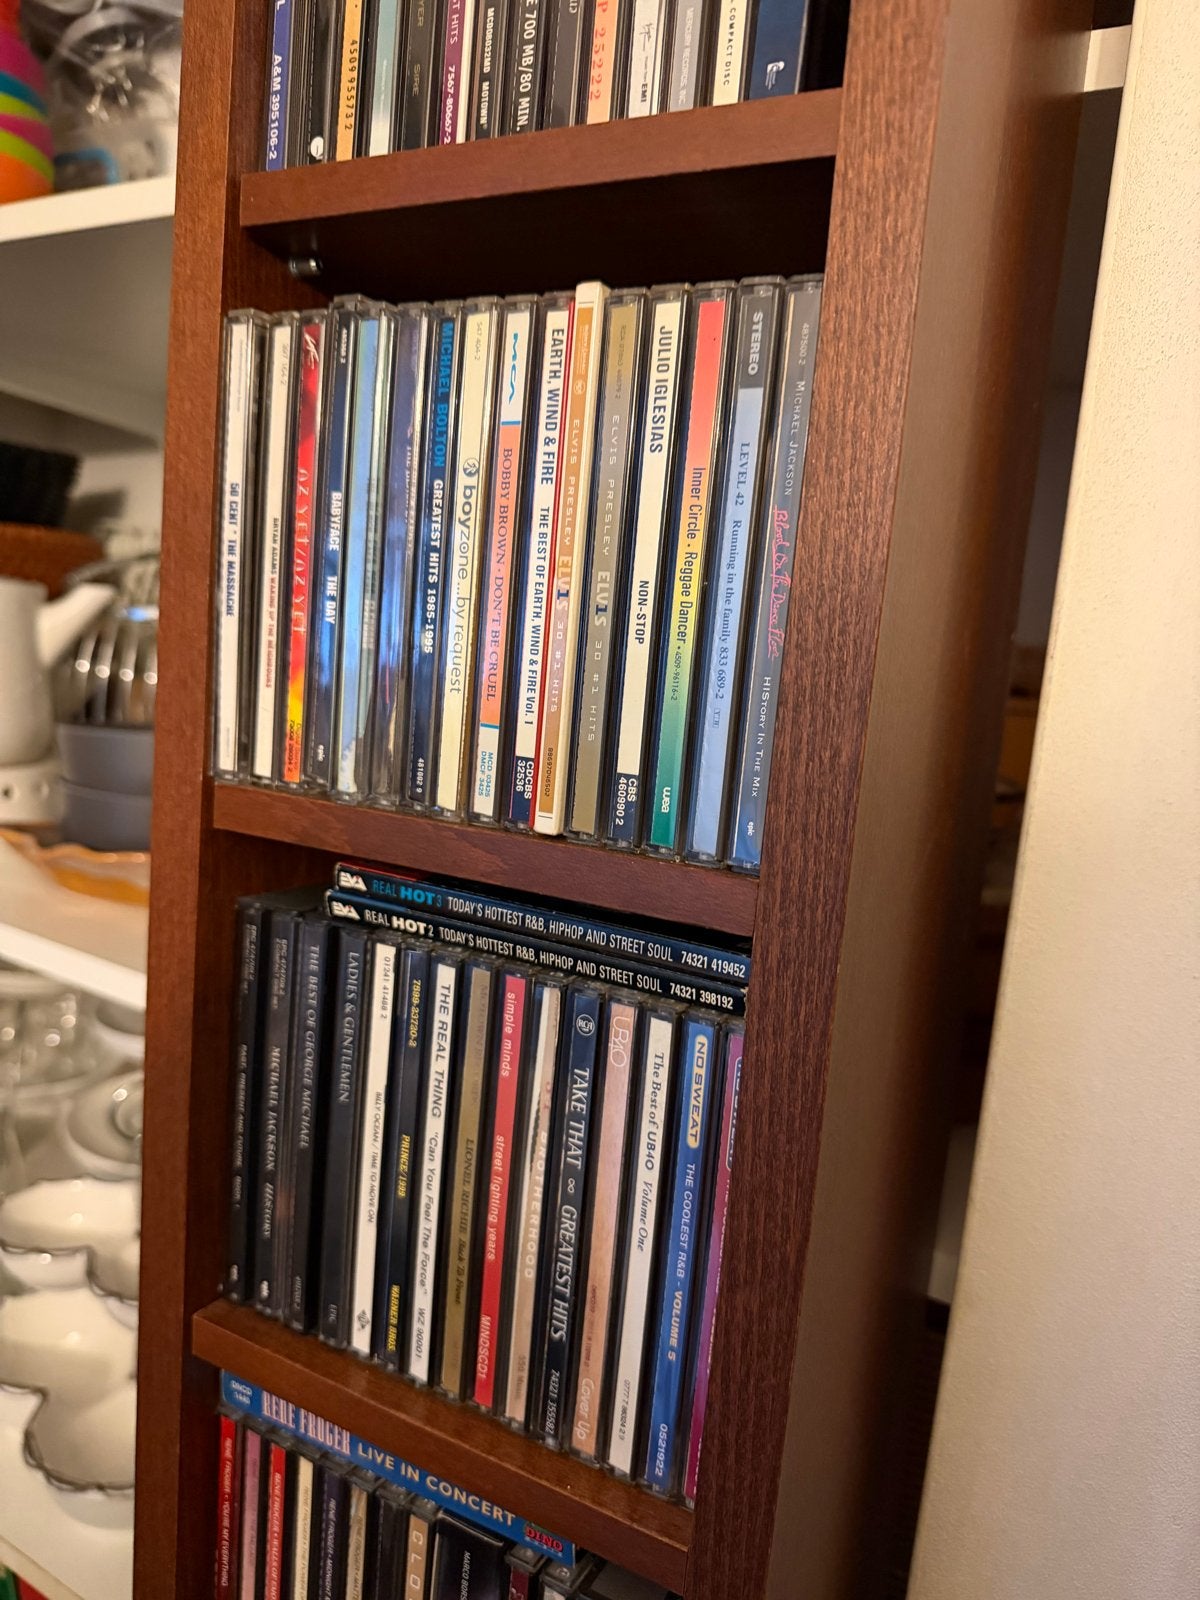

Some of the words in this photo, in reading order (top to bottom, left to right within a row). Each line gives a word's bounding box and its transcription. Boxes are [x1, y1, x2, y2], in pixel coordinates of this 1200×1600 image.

[450, 14, 459, 45] HITS
[523, 10, 537, 39] 700
[726, 7, 736, 57] COMPACT
[272, 54, 282, 91] A&M
[412, 64, 421, 97] SIRE
[518, 44, 535, 93] MB/80
[590, 27, 606, 101] 25222
[723, 61, 731, 86] DISC
[443, 64, 456, 144] 7567-80667-2
[517, 97, 530, 132] MIN.
[269, 94, 280, 159] 395106-2
[438, 322, 454, 397] MICHAEL
[548, 329, 565, 384] EARTH,
[656, 326, 672, 373] JULIO
[747, 311, 764, 375] STEREO
[545, 388, 560, 431] WIND
[650, 378, 668, 453] IGLESIAS
[434, 404, 448, 467] BOLTON
[544, 436, 556, 447] &
[570, 418, 580, 464] ELVIS
[609, 415, 620, 465] ELVIS
[500, 448, 512, 500] BOBBY
[541, 452, 555, 485] FIRE
[690, 467, 706, 500] Inner
[736, 442, 750, 489] LEVEL
[230, 482, 240, 497] 50
[735, 492, 745, 506] 42
[229, 501, 239, 526] CENT
[329, 491, 342, 551] BABYFACE
[430, 479, 444, 548] GREATEST
[539, 507, 550, 529] THE
[563, 476, 576, 545] PRESLEY
[602, 479, 615, 556] PRESLEY
[687, 504, 702, 539] Circle
[227, 539, 237, 557] THE
[271, 517, 279, 545] BRYAN
[496, 505, 509, 564] BROWN
[536, 532, 548, 562] BEST
[726, 520, 742, 570] Running
[327, 575, 338, 596] THE
[428, 552, 441, 583] HITS
[535, 565, 545, 579] OF
[679, 552, 698, 597] Reggae
[726, 573, 736, 583] in
[325, 601, 336, 624] DAY
[491, 576, 504, 626] DON'T
[531, 582, 544, 622] EARTH,
[635, 580, 649, 645] NON-STOP
[724, 587, 735, 605] the
[424, 589, 436, 653] 1985-1995
[490, 630, 500, 647] BE
[556, 621, 564, 640] 30
[677, 601, 693, 644] Dancer
[718, 607, 733, 644] family
[529, 624, 541, 655] WIND
[719, 646, 730, 666] 833
[448, 625, 464, 694] request
[486, 651, 499, 701] CRUEL
[528, 658, 538, 667] &
[554, 650, 562, 670] #1
[526, 669, 537, 694] FIRE
[550, 679, 560, 712] HITS
[591, 673, 599, 694] #1
[715, 669, 726, 699] 689-2
[525, 696, 535, 716] Vol.
[587, 705, 597, 741] HITS
[479, 751, 487, 774] DMCF
[516, 760, 525, 792] 32536
[524, 760, 534, 799] CDCBS
[477, 777, 485, 796] 3425
[484, 774, 492, 798] 03425
[627, 778, 637, 802] CBS
[747, 821, 755, 837] epic
[372, 879, 397, 897] REAL
[399, 886, 435, 905] HOT
[436, 895, 442, 907] 3
[447, 896, 483, 917] TODAY'S
[485, 905, 523, 927] HOTTEST
[525, 915, 547, 933] R&B,
[549, 920, 584, 940] HIPHOP
[585, 929, 607, 946] AND
[609, 934, 645, 955] STREET
[647, 943, 673, 962] SOUL
[681, 951, 708, 969] 74321
[711, 958, 746, 978] 419452
[309, 945, 320, 972] THE
[345, 952, 360, 999] LADIES
[363, 909, 390, 926] REAL
[391, 915, 427, 935] HOT
[428, 925, 434, 937] 2
[439, 926, 474, 947] TODAY'S
[476, 935, 514, 956] HOTTEST
[516, 945, 538, 964] R&B,
[539, 951, 574, 970] HIPHOP
[576, 959, 597, 976] AND
[599, 966, 634, 985] STREET
[636, 975, 662, 993] SOUL
[669, 982, 696, 1001] 74321
[699, 990, 734, 1010] 398192
[308, 975, 319, 1007] BEST
[344, 1002, 355, 1014] &
[439, 984, 451, 1016] THE
[306, 1009, 317, 1029] OF
[504, 992, 517, 1034] simple
[303, 1030, 315, 1085] GEORGE
[339, 1016, 354, 1102] GENTLEMEN
[435, 1020, 448, 1062] REAL
[501, 1039, 515, 1077] minds
[695, 1041, 706, 1068] NO
[652, 1052, 665, 1078] The
[431, 1069, 445, 1119] THING
[570, 1067, 590, 1114] TAKE
[650, 1080, 662, 1110] Best
[689, 1072, 703, 1143] SWEAT
[299, 1088, 312, 1149] MICHAEL
[648, 1112, 659, 1129] of
[463, 1137, 475, 1186] LIONEL
[493, 1135, 505, 1171] street
[566, 1119, 586, 1170] THAT
[645, 1131, 657, 1171] UB40
[425, 1167, 437, 1190] You
[684, 1163, 696, 1187] THE
[638, 1180, 653, 1226] Volume
[679, 1191, 693, 1250] COOLEST
[422, 1227, 432, 1249] The
[487, 1227, 498, 1262] years
[554, 1205, 577, 1297] GREATEST
[637, 1227, 648, 1252] One
[675, 1251, 688, 1278] R&B
[550, 1298, 570, 1342] HITS
[669, 1290, 683, 1347] VOLUME
[578, 1378, 594, 1419] Cover
[575, 1420, 591, 1440] Up
[654, 1423, 668, 1477] 0521922
[357, 1442, 395, 1470] LIVE
[400, 1461, 420, 1482] IN
[425, 1475, 517, 1526] CONCERT
[526, 1526, 563, 1552] DINO
[221, 1528, 229, 1539] MY
[221, 1540, 229, 1586] EVERYTHING
[462, 1551, 471, 1579] MARCO
